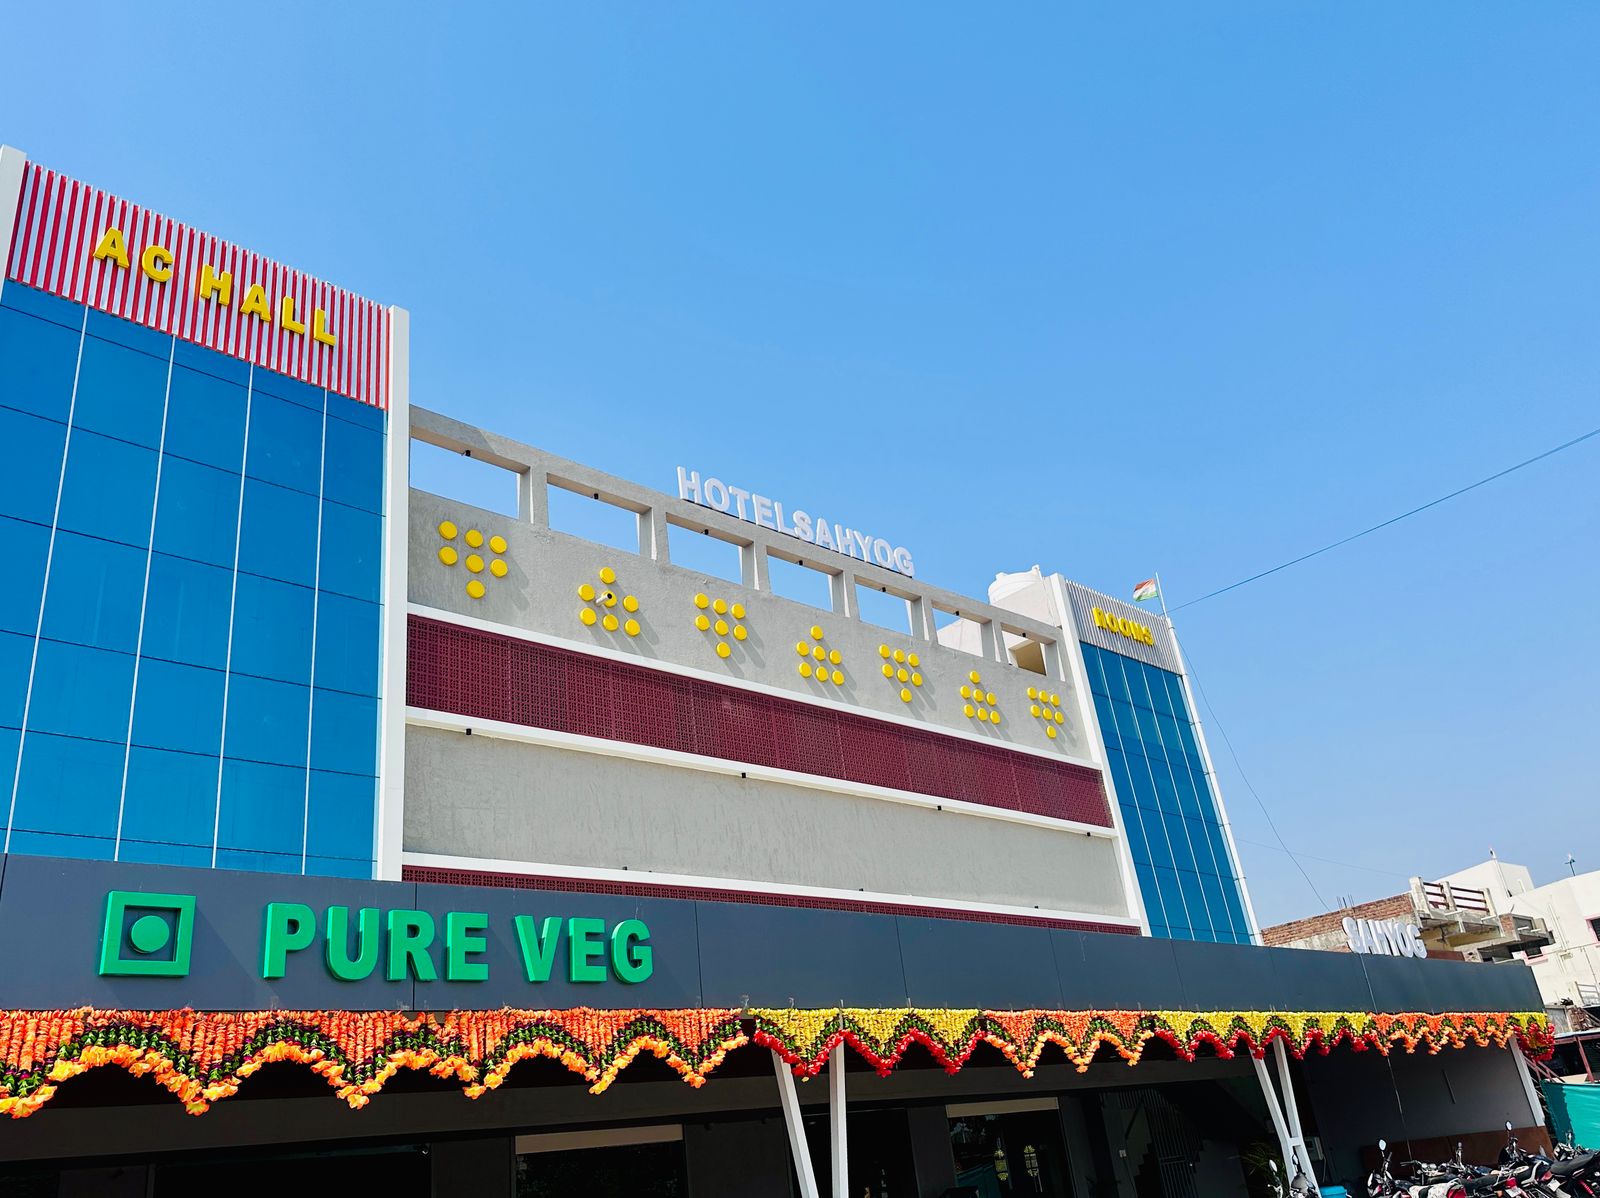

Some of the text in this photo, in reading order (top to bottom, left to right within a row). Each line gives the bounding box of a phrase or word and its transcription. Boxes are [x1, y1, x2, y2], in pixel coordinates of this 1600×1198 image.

[93, 227, 336, 347] AC HALL
[263, 902, 653, 984] PURE VEG
[1342, 917, 1427, 959] SAHYOG
